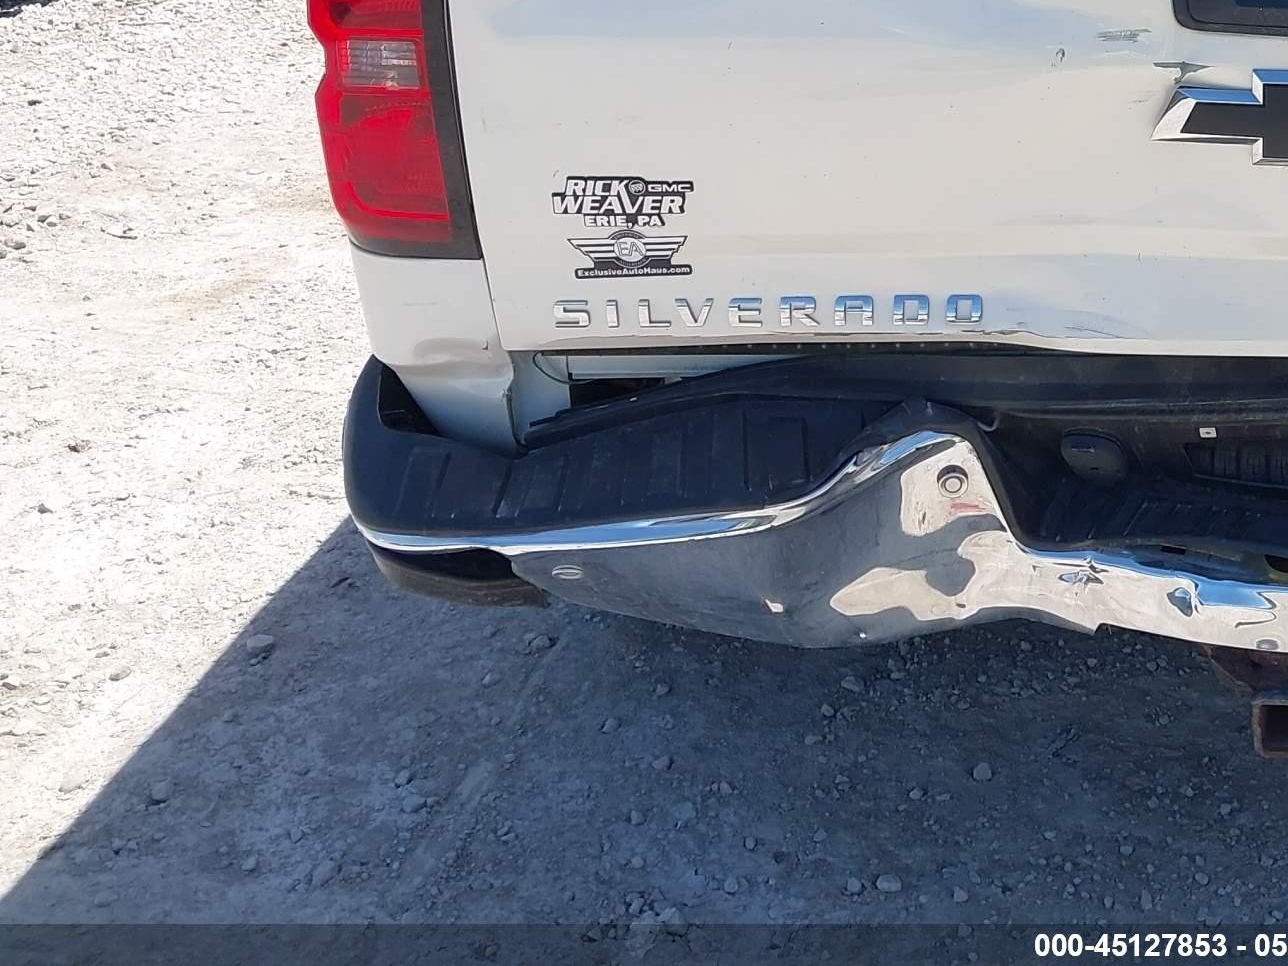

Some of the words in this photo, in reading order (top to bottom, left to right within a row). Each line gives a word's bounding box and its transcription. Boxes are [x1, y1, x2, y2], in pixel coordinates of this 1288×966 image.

[564, 179, 630, 196] RICK
[647, 183, 692, 193] GMC
[552, 195, 684, 215] WEAVER
[584, 215, 633, 228] ERIE,
[637, 215, 663, 227] PA
[577, 266, 691, 277] ExclusiveAutoHaus.com
[553, 294, 985, 329] SILVERADO
